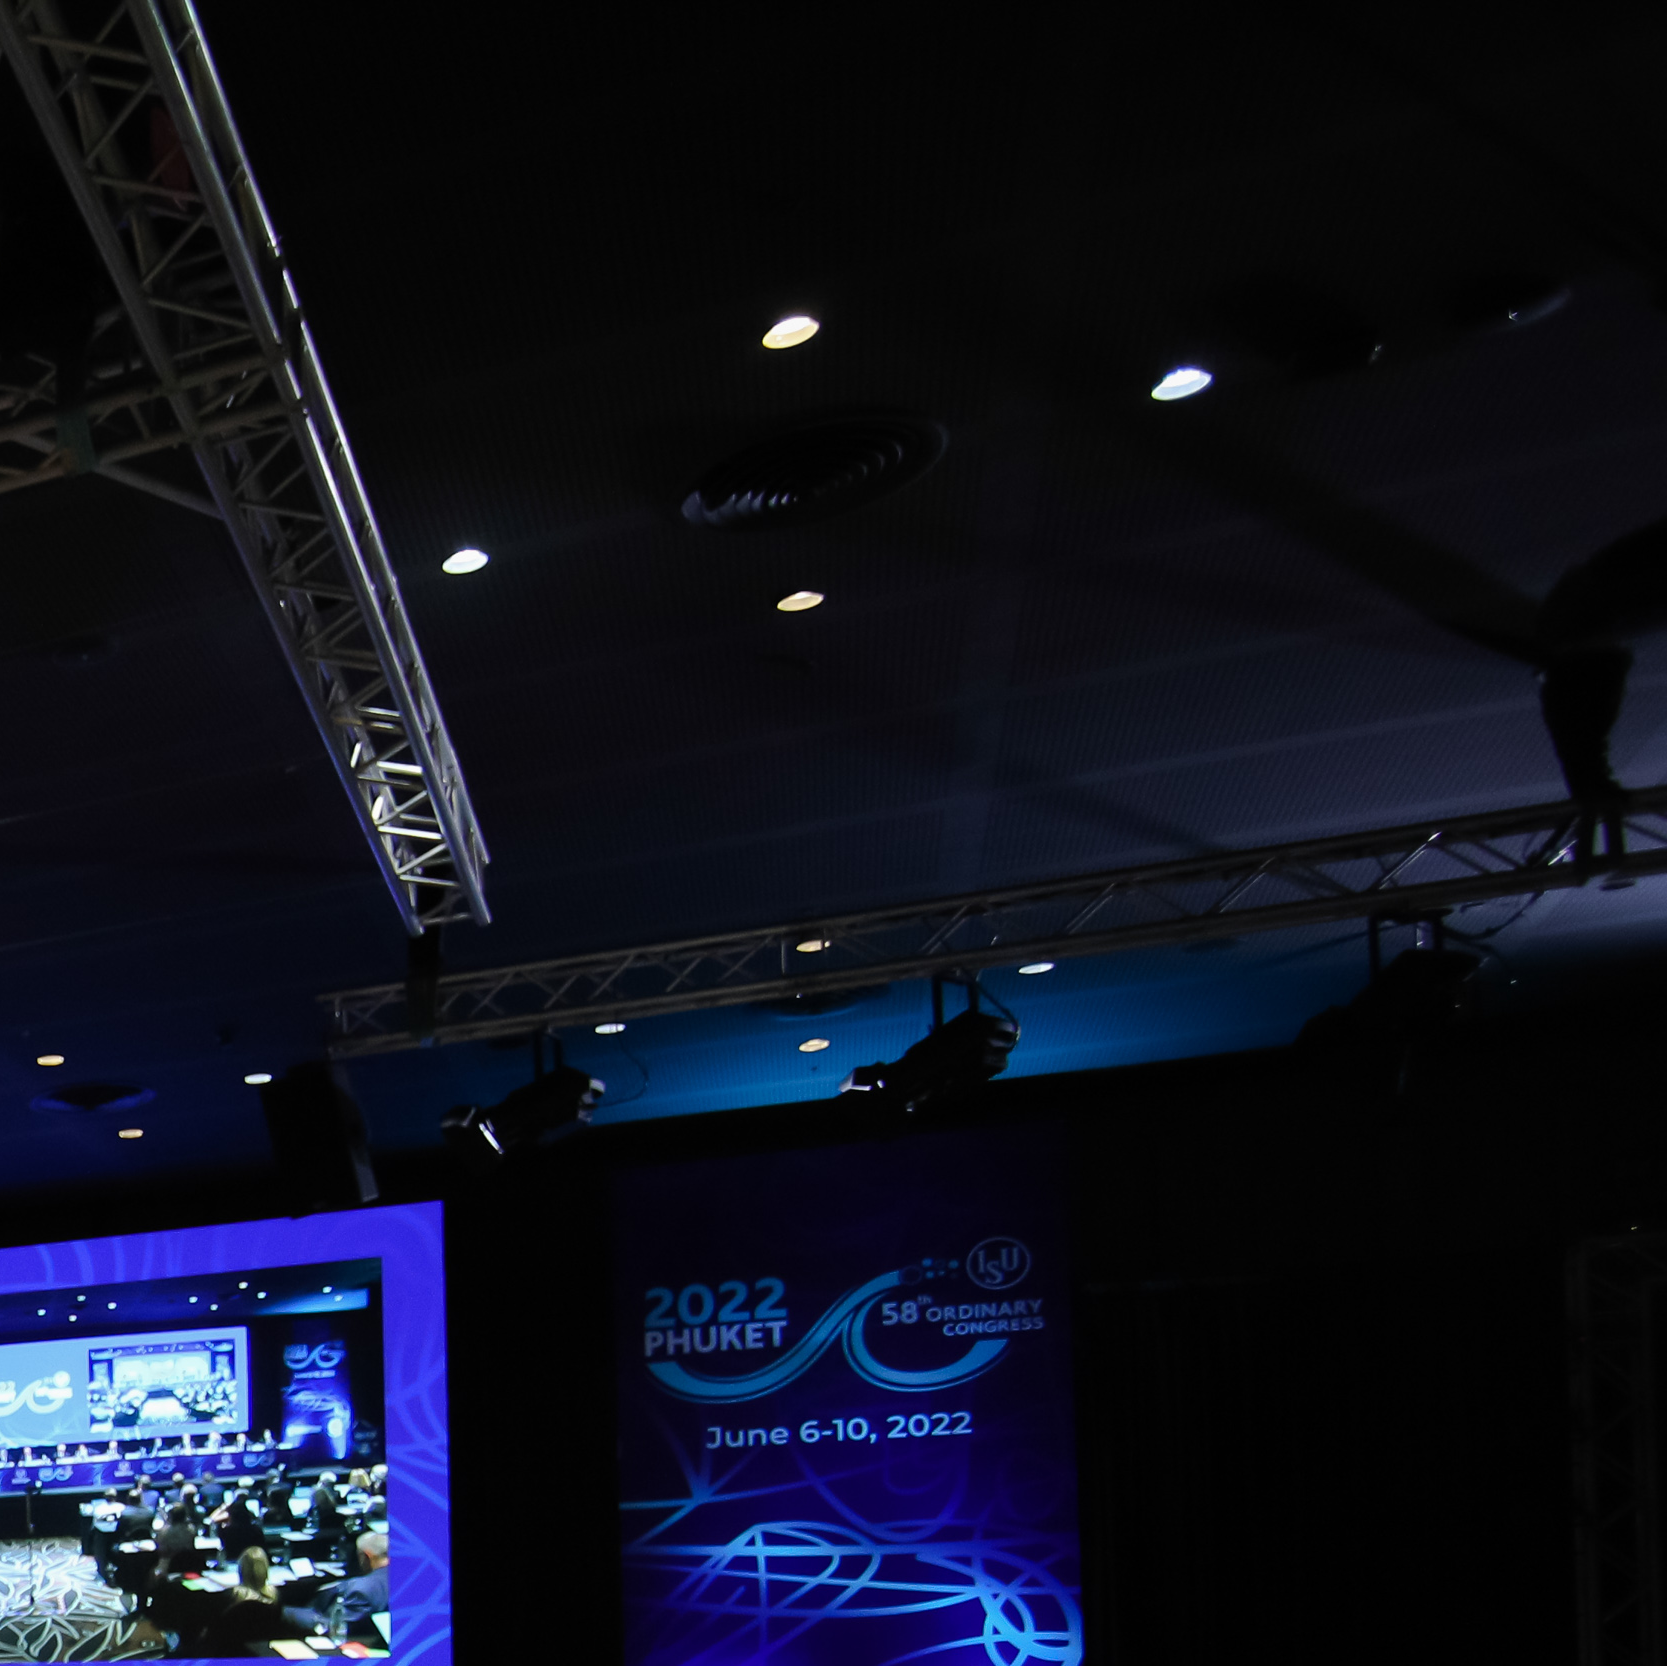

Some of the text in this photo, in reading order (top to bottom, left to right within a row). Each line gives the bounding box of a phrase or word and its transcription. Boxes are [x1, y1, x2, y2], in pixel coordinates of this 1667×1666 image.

[644, 1277, 787, 1329] 2022
[881, 1295, 1044, 1326] 58th ORDINARY
[644, 1320, 787, 1357] PHUKET
[942, 1316, 1044, 1337] CONGRESS
[706, 1410, 972, 1449] June 6-10, 2022
